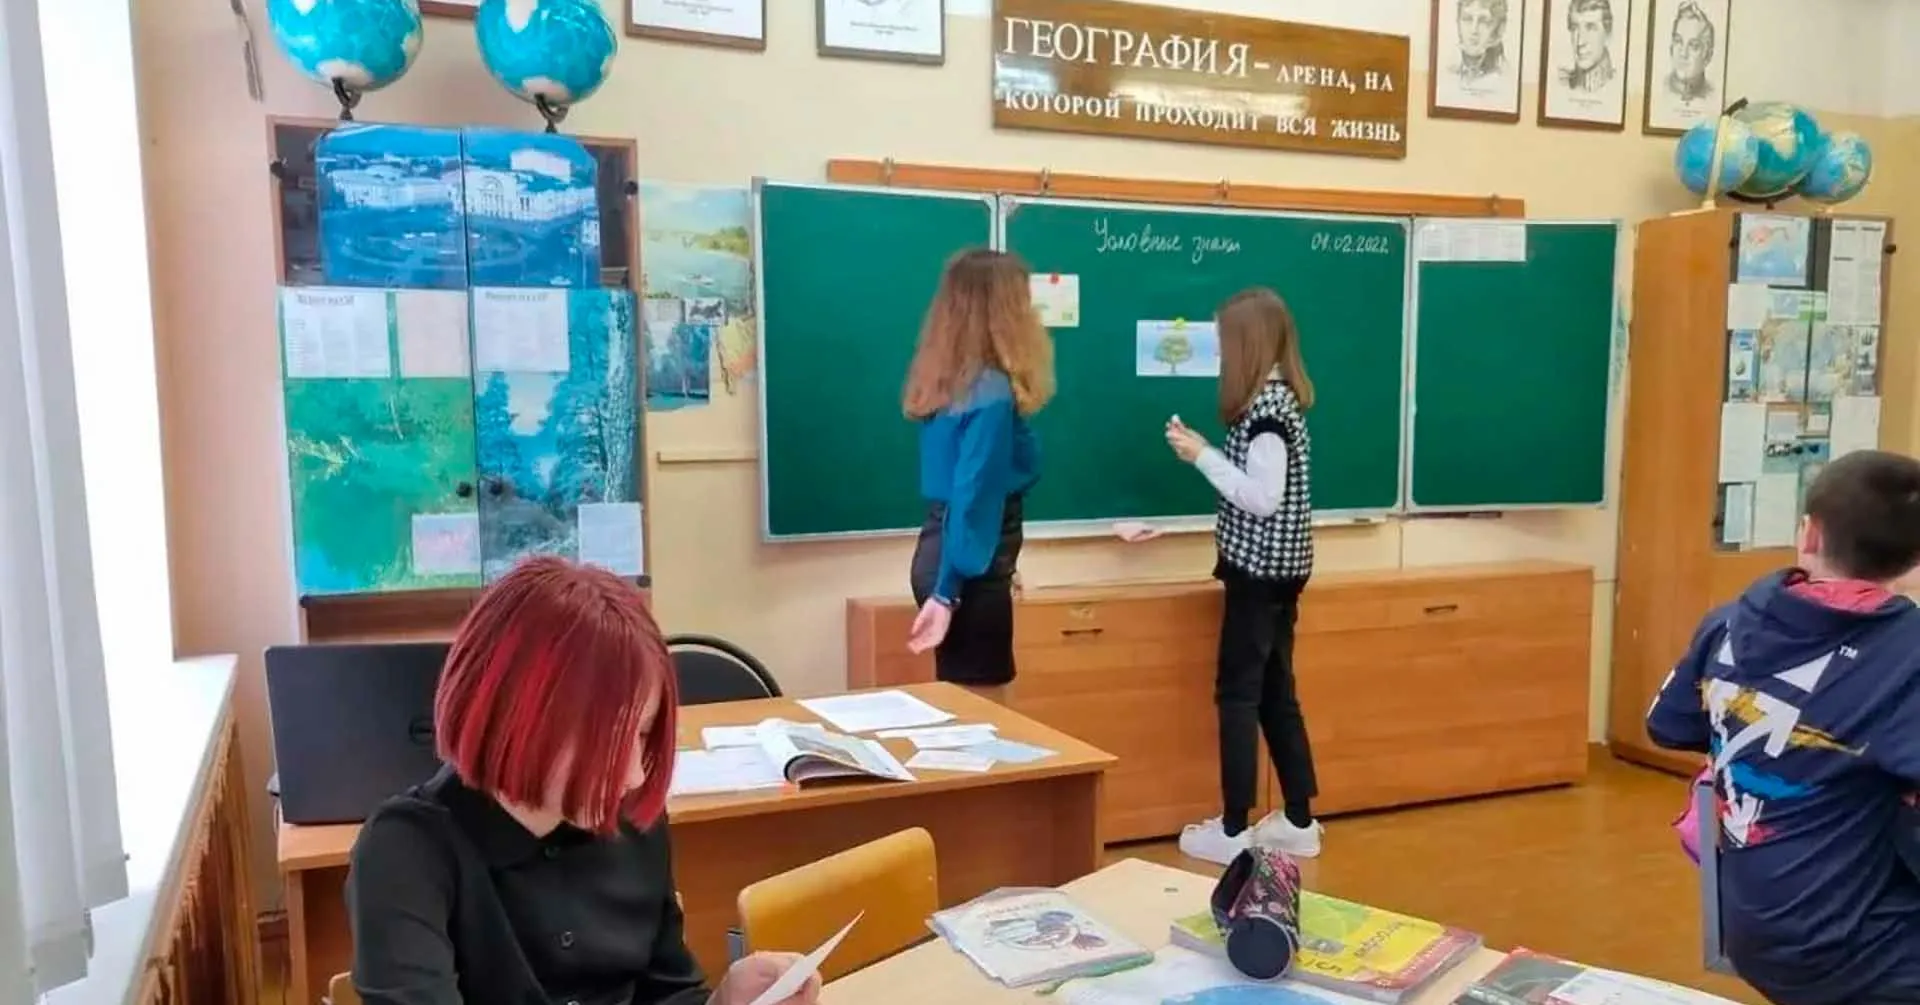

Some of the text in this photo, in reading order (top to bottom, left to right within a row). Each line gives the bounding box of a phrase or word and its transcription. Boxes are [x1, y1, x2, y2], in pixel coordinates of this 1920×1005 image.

[1277, 65, 1356, 94] АРЕНА,
[1364, 73, 1393, 92] НА
[1003, 92, 1401, 143] КОТОРОЙ ПРОХОДИТ ВСЯ ЖИЗНЬ
[1839, 645, 1858, 659] TM
